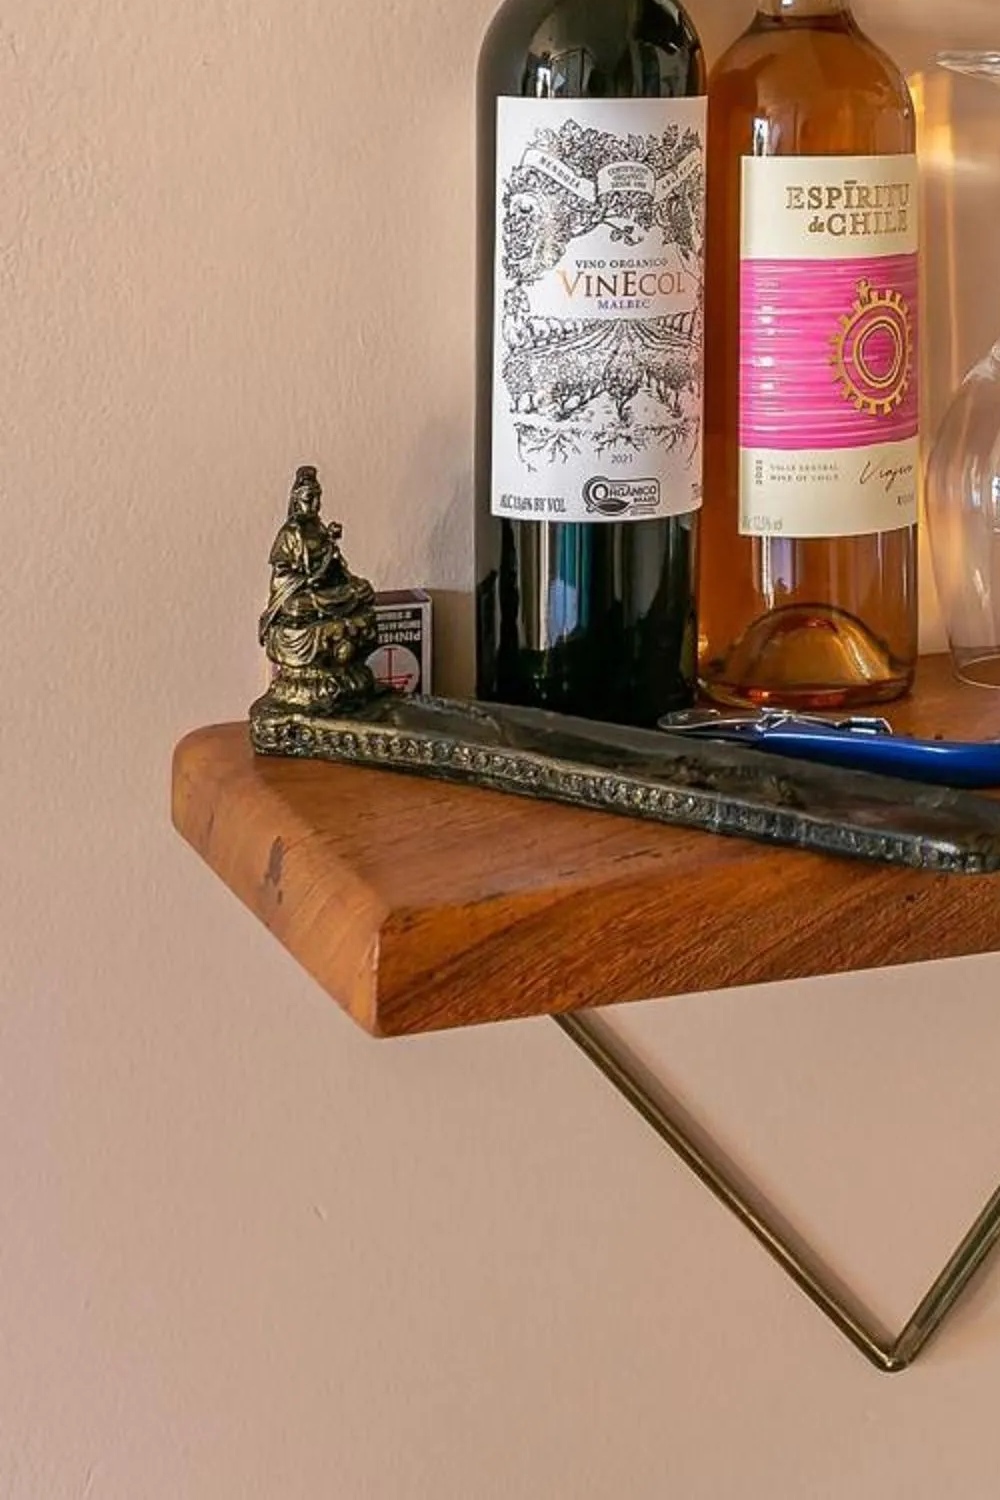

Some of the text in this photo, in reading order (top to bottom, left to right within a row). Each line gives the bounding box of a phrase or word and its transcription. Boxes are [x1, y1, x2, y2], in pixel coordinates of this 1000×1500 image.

[826, 210, 908, 236] CHILE
[575, 259, 606, 269] VINO
[598, 299, 651, 310] MALBEC
[611, 453, 634, 464] 2021
